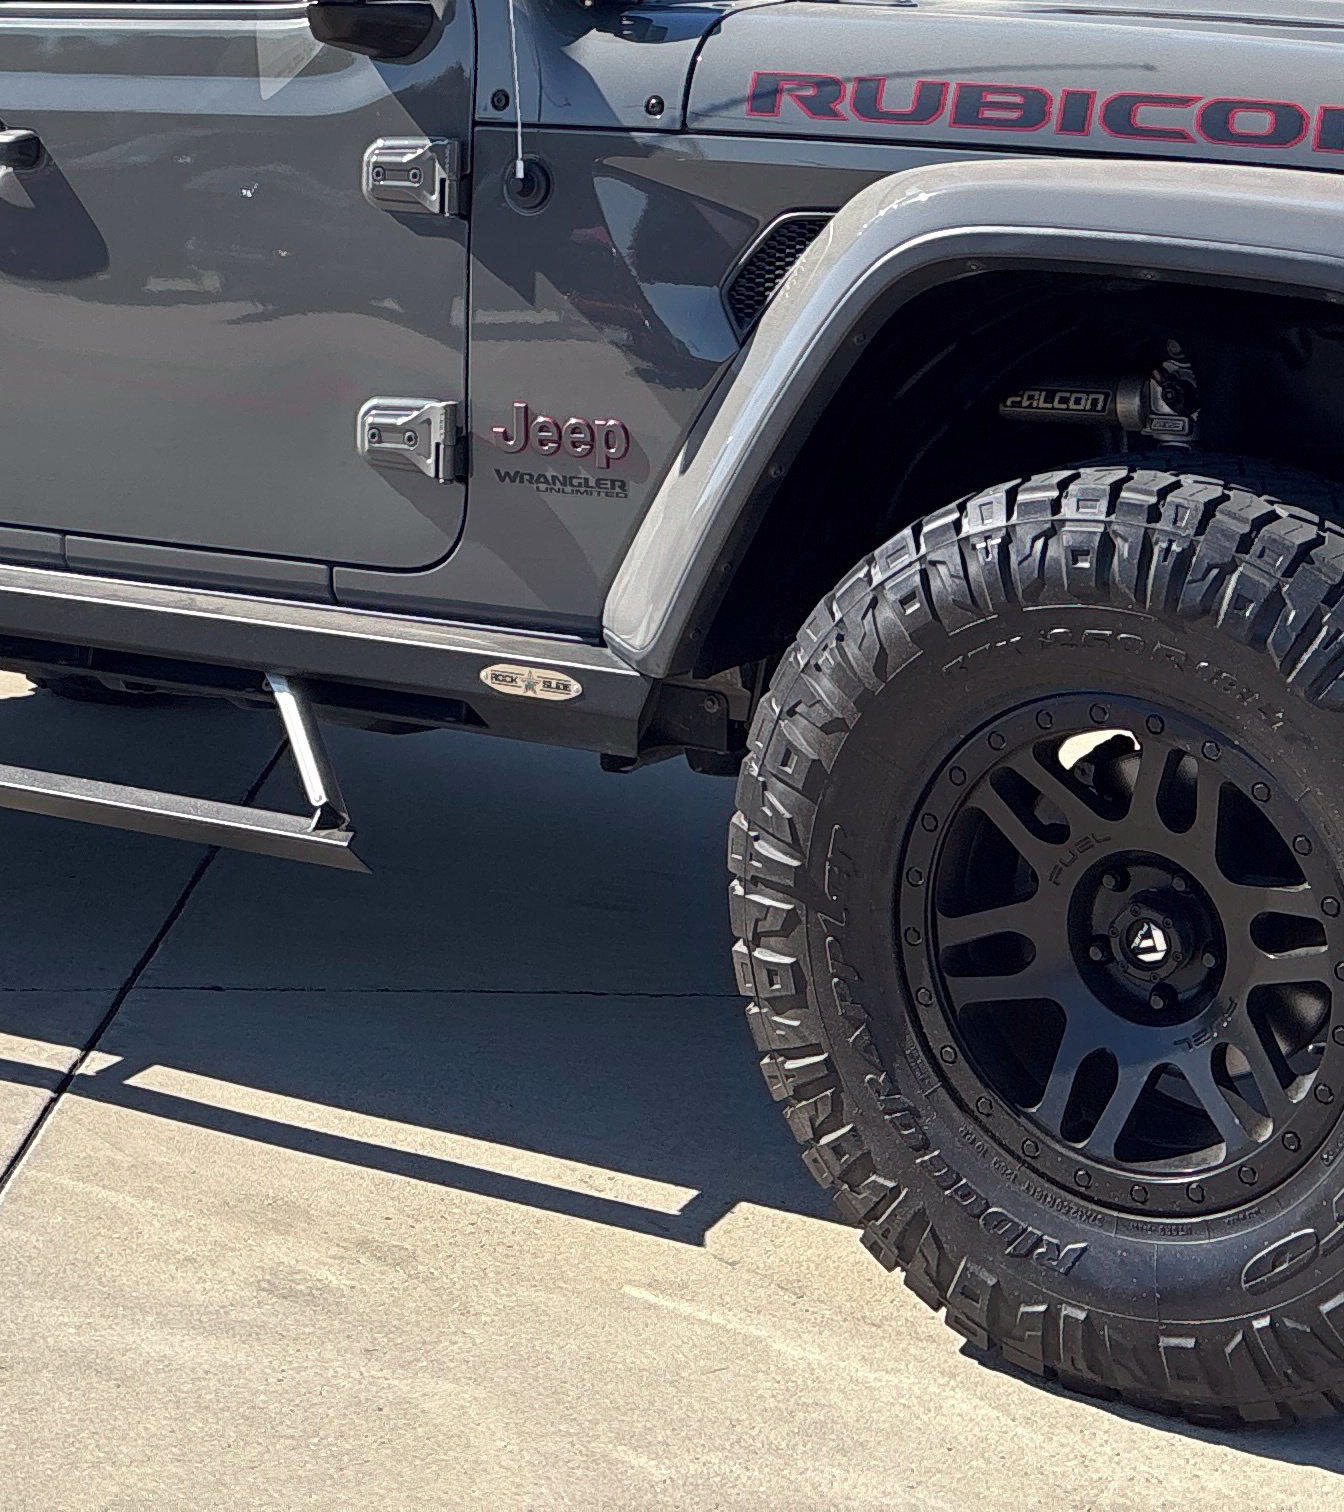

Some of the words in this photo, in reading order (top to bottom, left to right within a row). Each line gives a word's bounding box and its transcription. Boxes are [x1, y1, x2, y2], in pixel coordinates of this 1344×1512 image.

[492, 400, 630, 470] Jeep
[494, 468, 629, 492] WRANGLER
[535, 485, 629, 499] UNLIMITED
[490, 672, 518, 685] ROCK
[1048, 832, 1112, 886] FUEL
